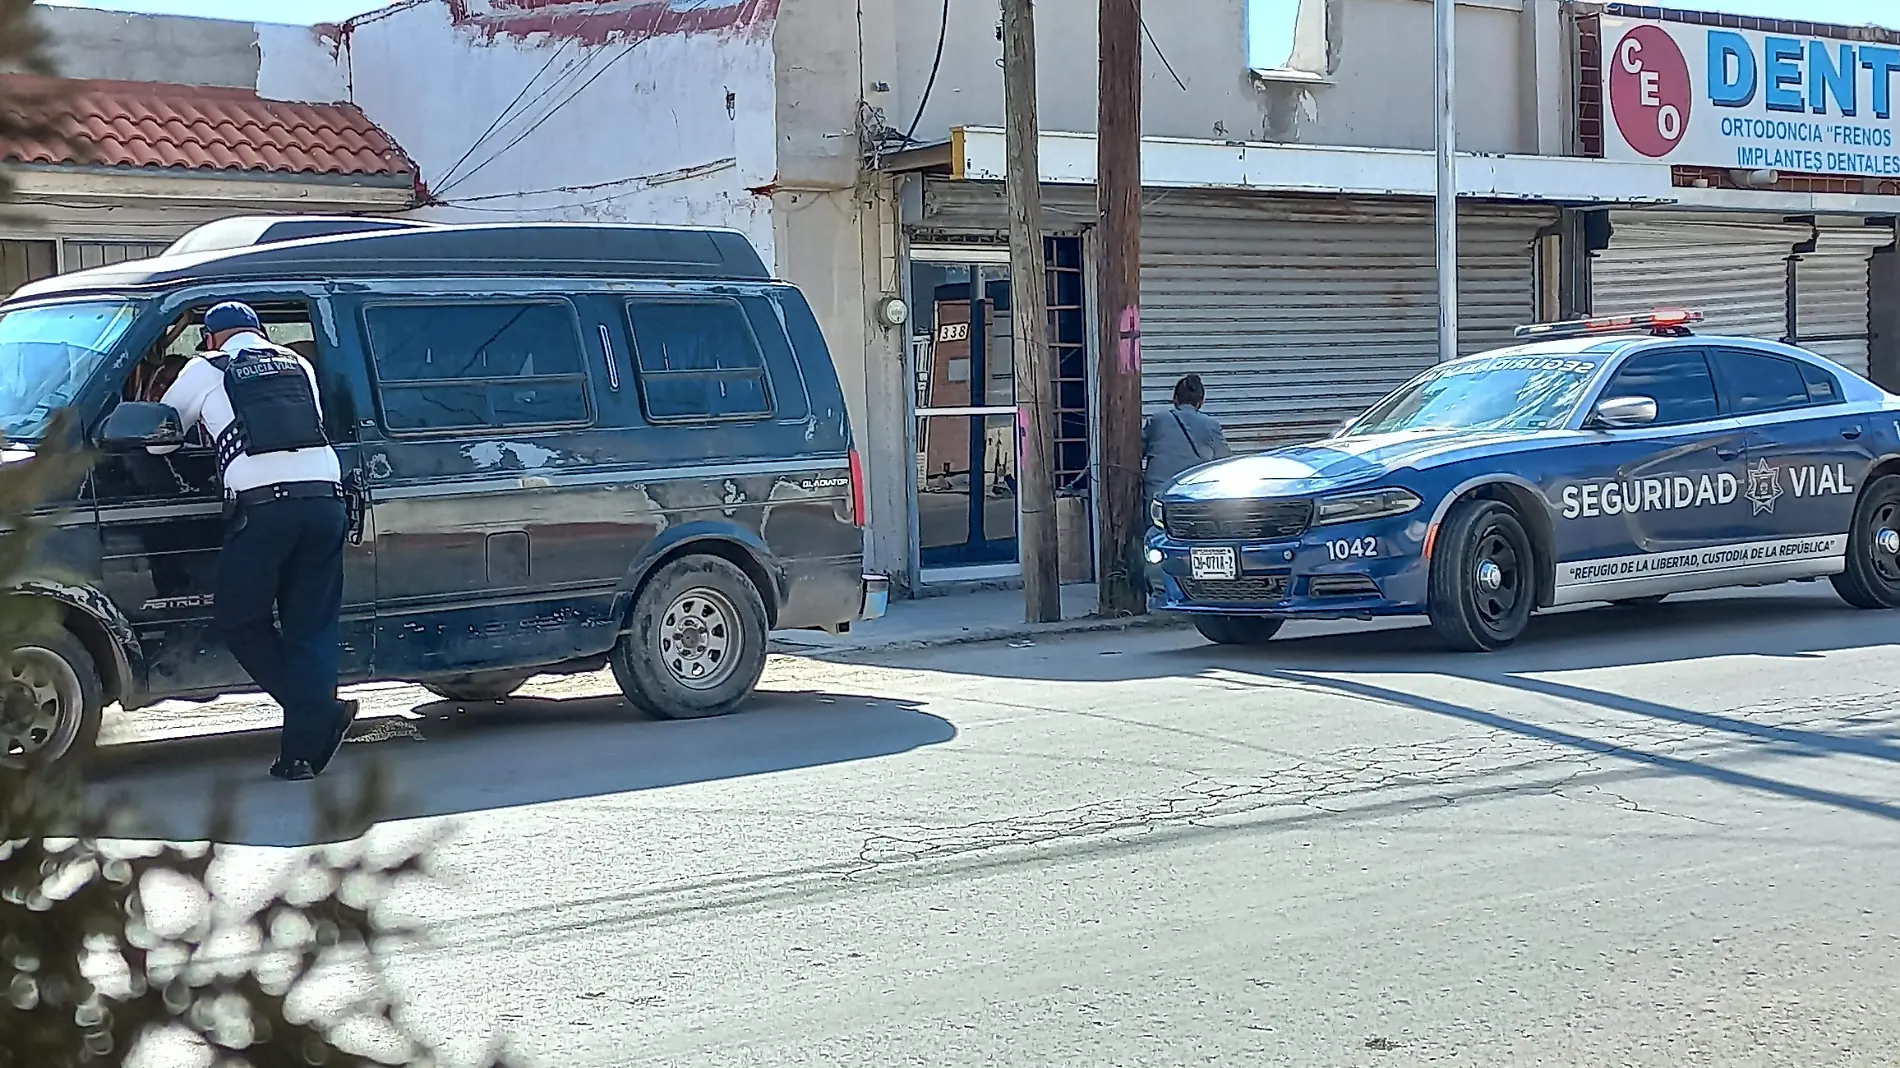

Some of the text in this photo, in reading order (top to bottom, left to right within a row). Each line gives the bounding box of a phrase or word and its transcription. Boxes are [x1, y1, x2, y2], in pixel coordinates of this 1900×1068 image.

[1620, 37, 1681, 141] CEO
[1721, 117, 1823, 143] ORTODONCIA
[1737, 146, 1900, 175] IMPLANTES DENTALES
[941, 325, 966, 340] 338
[236, 363, 274, 378] POLICIA
[802, 478, 849, 488] GLADIATOR
[1562, 463, 1853, 519] SEGURIDAD VIAL
[1325, 536, 1378, 560] 1042
[1620, 561, 1634, 574] DE
[1635, 559, 1649, 572] LA
[1651, 554, 1700, 570] LIBERTAD,
[1702, 549, 1749, 564] CUSTODIA
[1750, 547, 1764, 559] DE
[1765, 546, 1777, 558] LA
[139, 596, 200, 610] ASTRO
